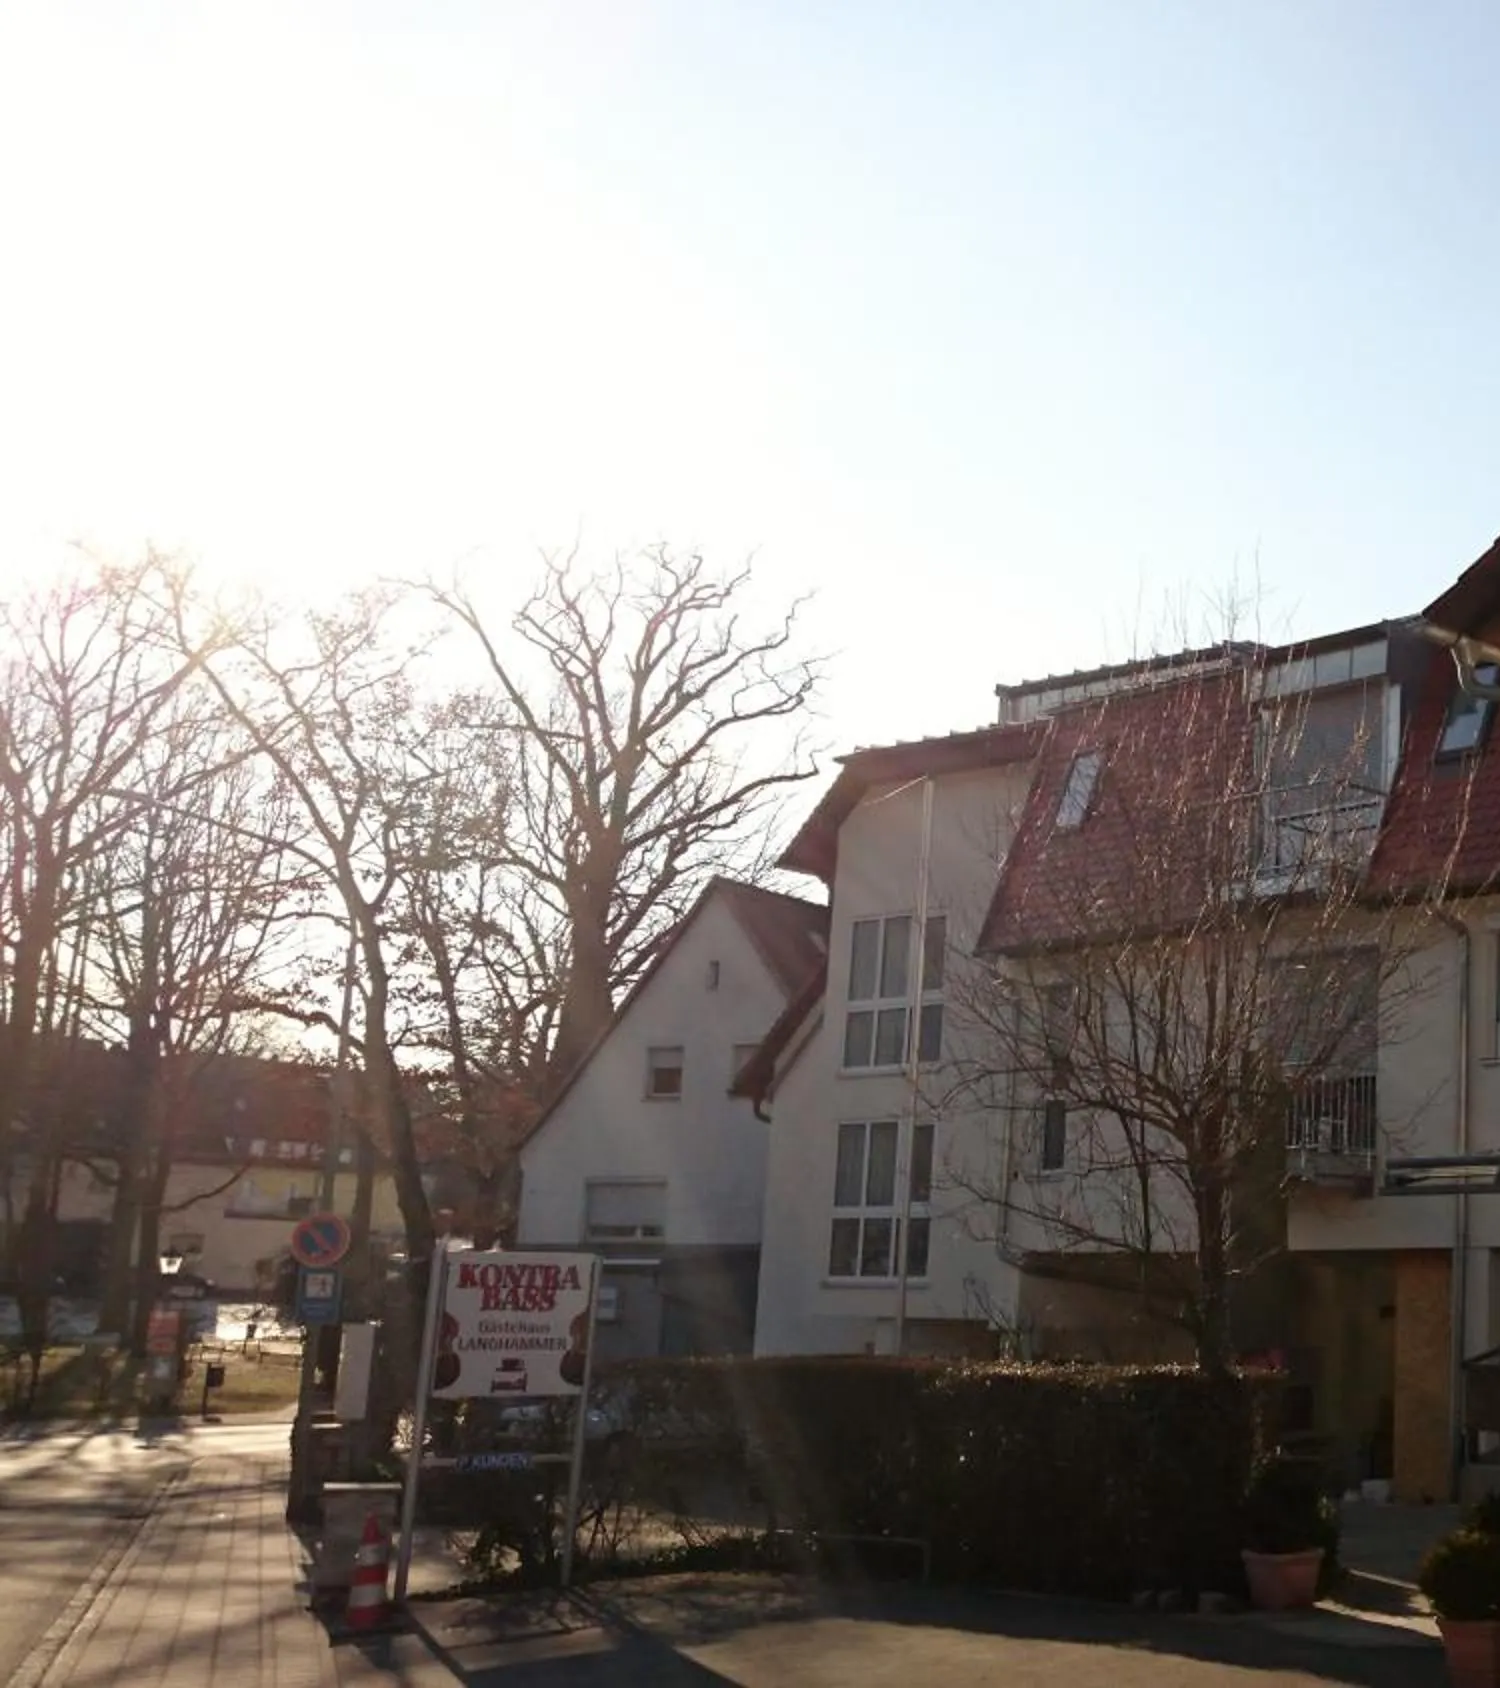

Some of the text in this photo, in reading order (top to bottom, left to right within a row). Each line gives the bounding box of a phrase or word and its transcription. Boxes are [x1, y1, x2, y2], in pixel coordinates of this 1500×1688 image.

[456, 1263, 581, 1290] KONTRA
[480, 1286, 556, 1311] BASS
[478, 1320, 551, 1334] Gästehaus
[458, 1337, 567, 1350] LANGHAMMER
